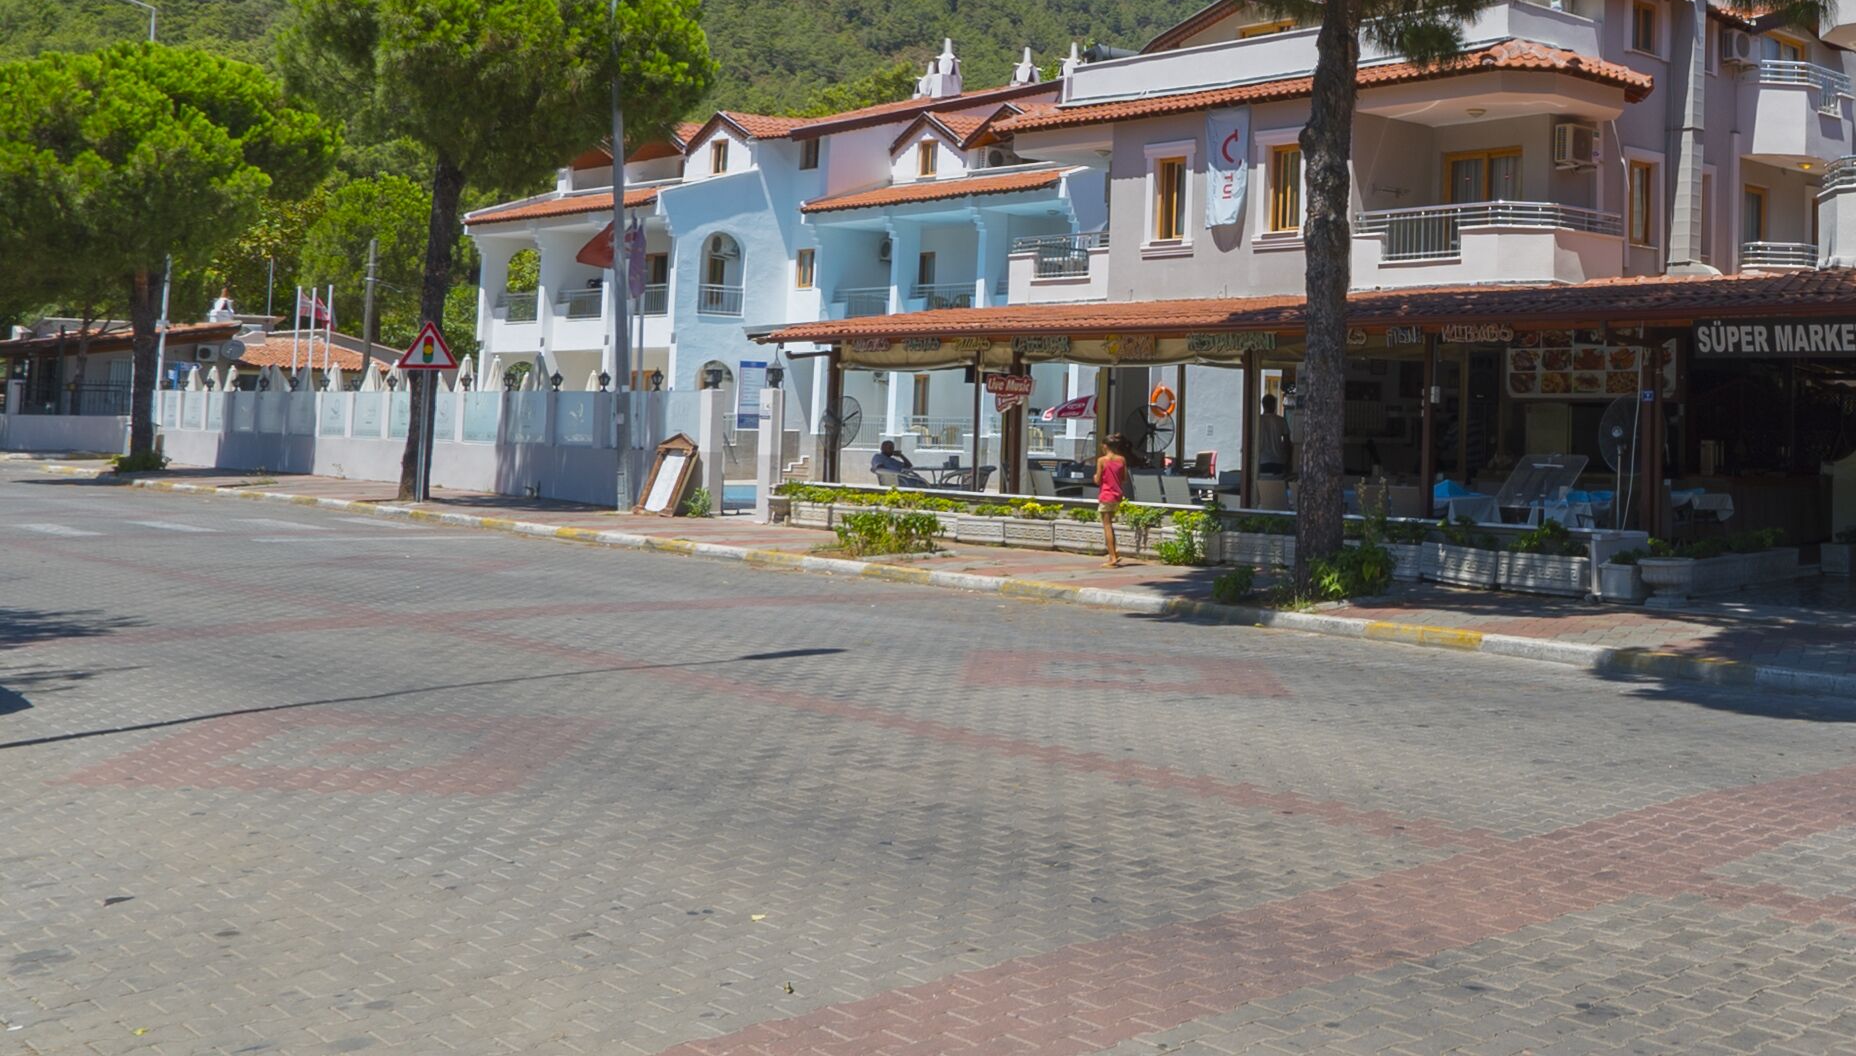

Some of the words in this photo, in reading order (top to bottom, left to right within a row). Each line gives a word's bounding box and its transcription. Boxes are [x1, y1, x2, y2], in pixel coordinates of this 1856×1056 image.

[1222, 172, 1234, 200] TUI
[1697, 320, 1770, 353] SÜPER
[987, 377, 1004, 391] Live
[1005, 376, 1031, 393] Music
